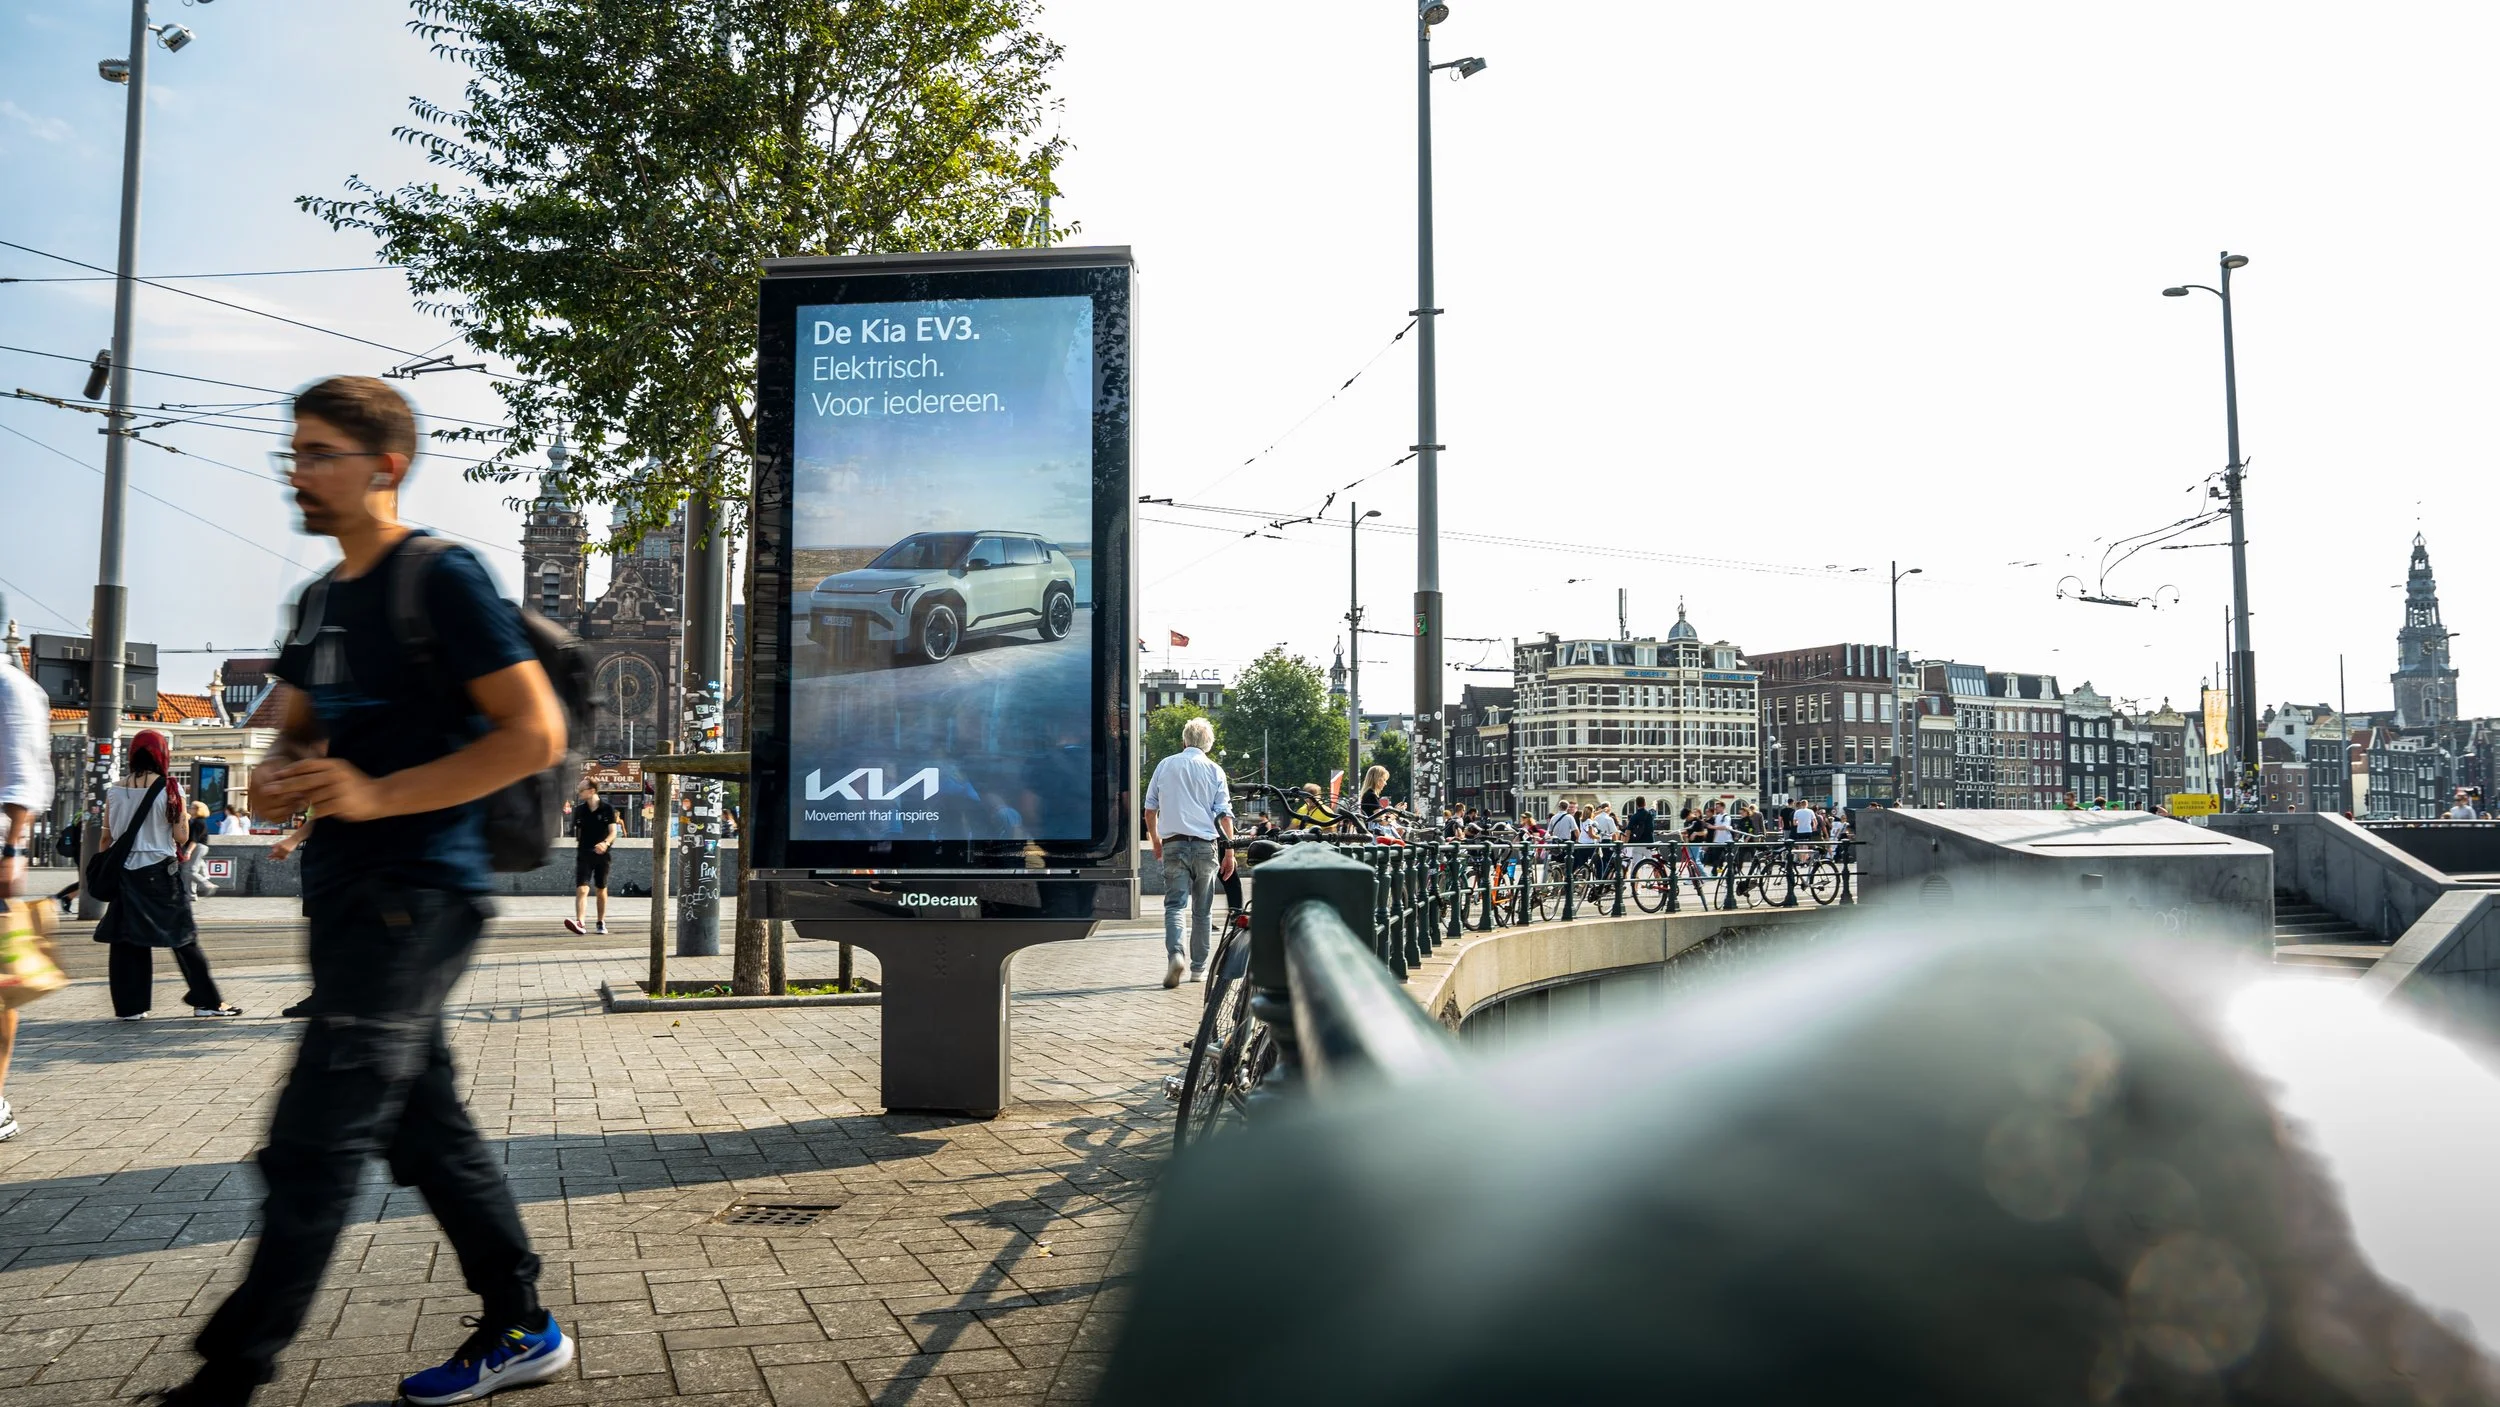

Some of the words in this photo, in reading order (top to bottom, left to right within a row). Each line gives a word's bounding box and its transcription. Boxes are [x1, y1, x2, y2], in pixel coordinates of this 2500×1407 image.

[814, 320, 851, 345] De
[861, 318, 905, 343] Kia
[917, 316, 980, 342] EV3.
[813, 353, 944, 381] Elektrisch.
[812, 392, 874, 417] Voor
[883, 389, 1006, 415] iedereen.
[805, 767, 939, 801] KIA
[805, 809, 866, 821] Movement
[869, 809, 893, 821] that
[895, 809, 939, 824] inspires
[214, 864, 222, 872] B
[700, 861, 718, 879] Pink
[898, 893, 978, 907] JCDecaux
